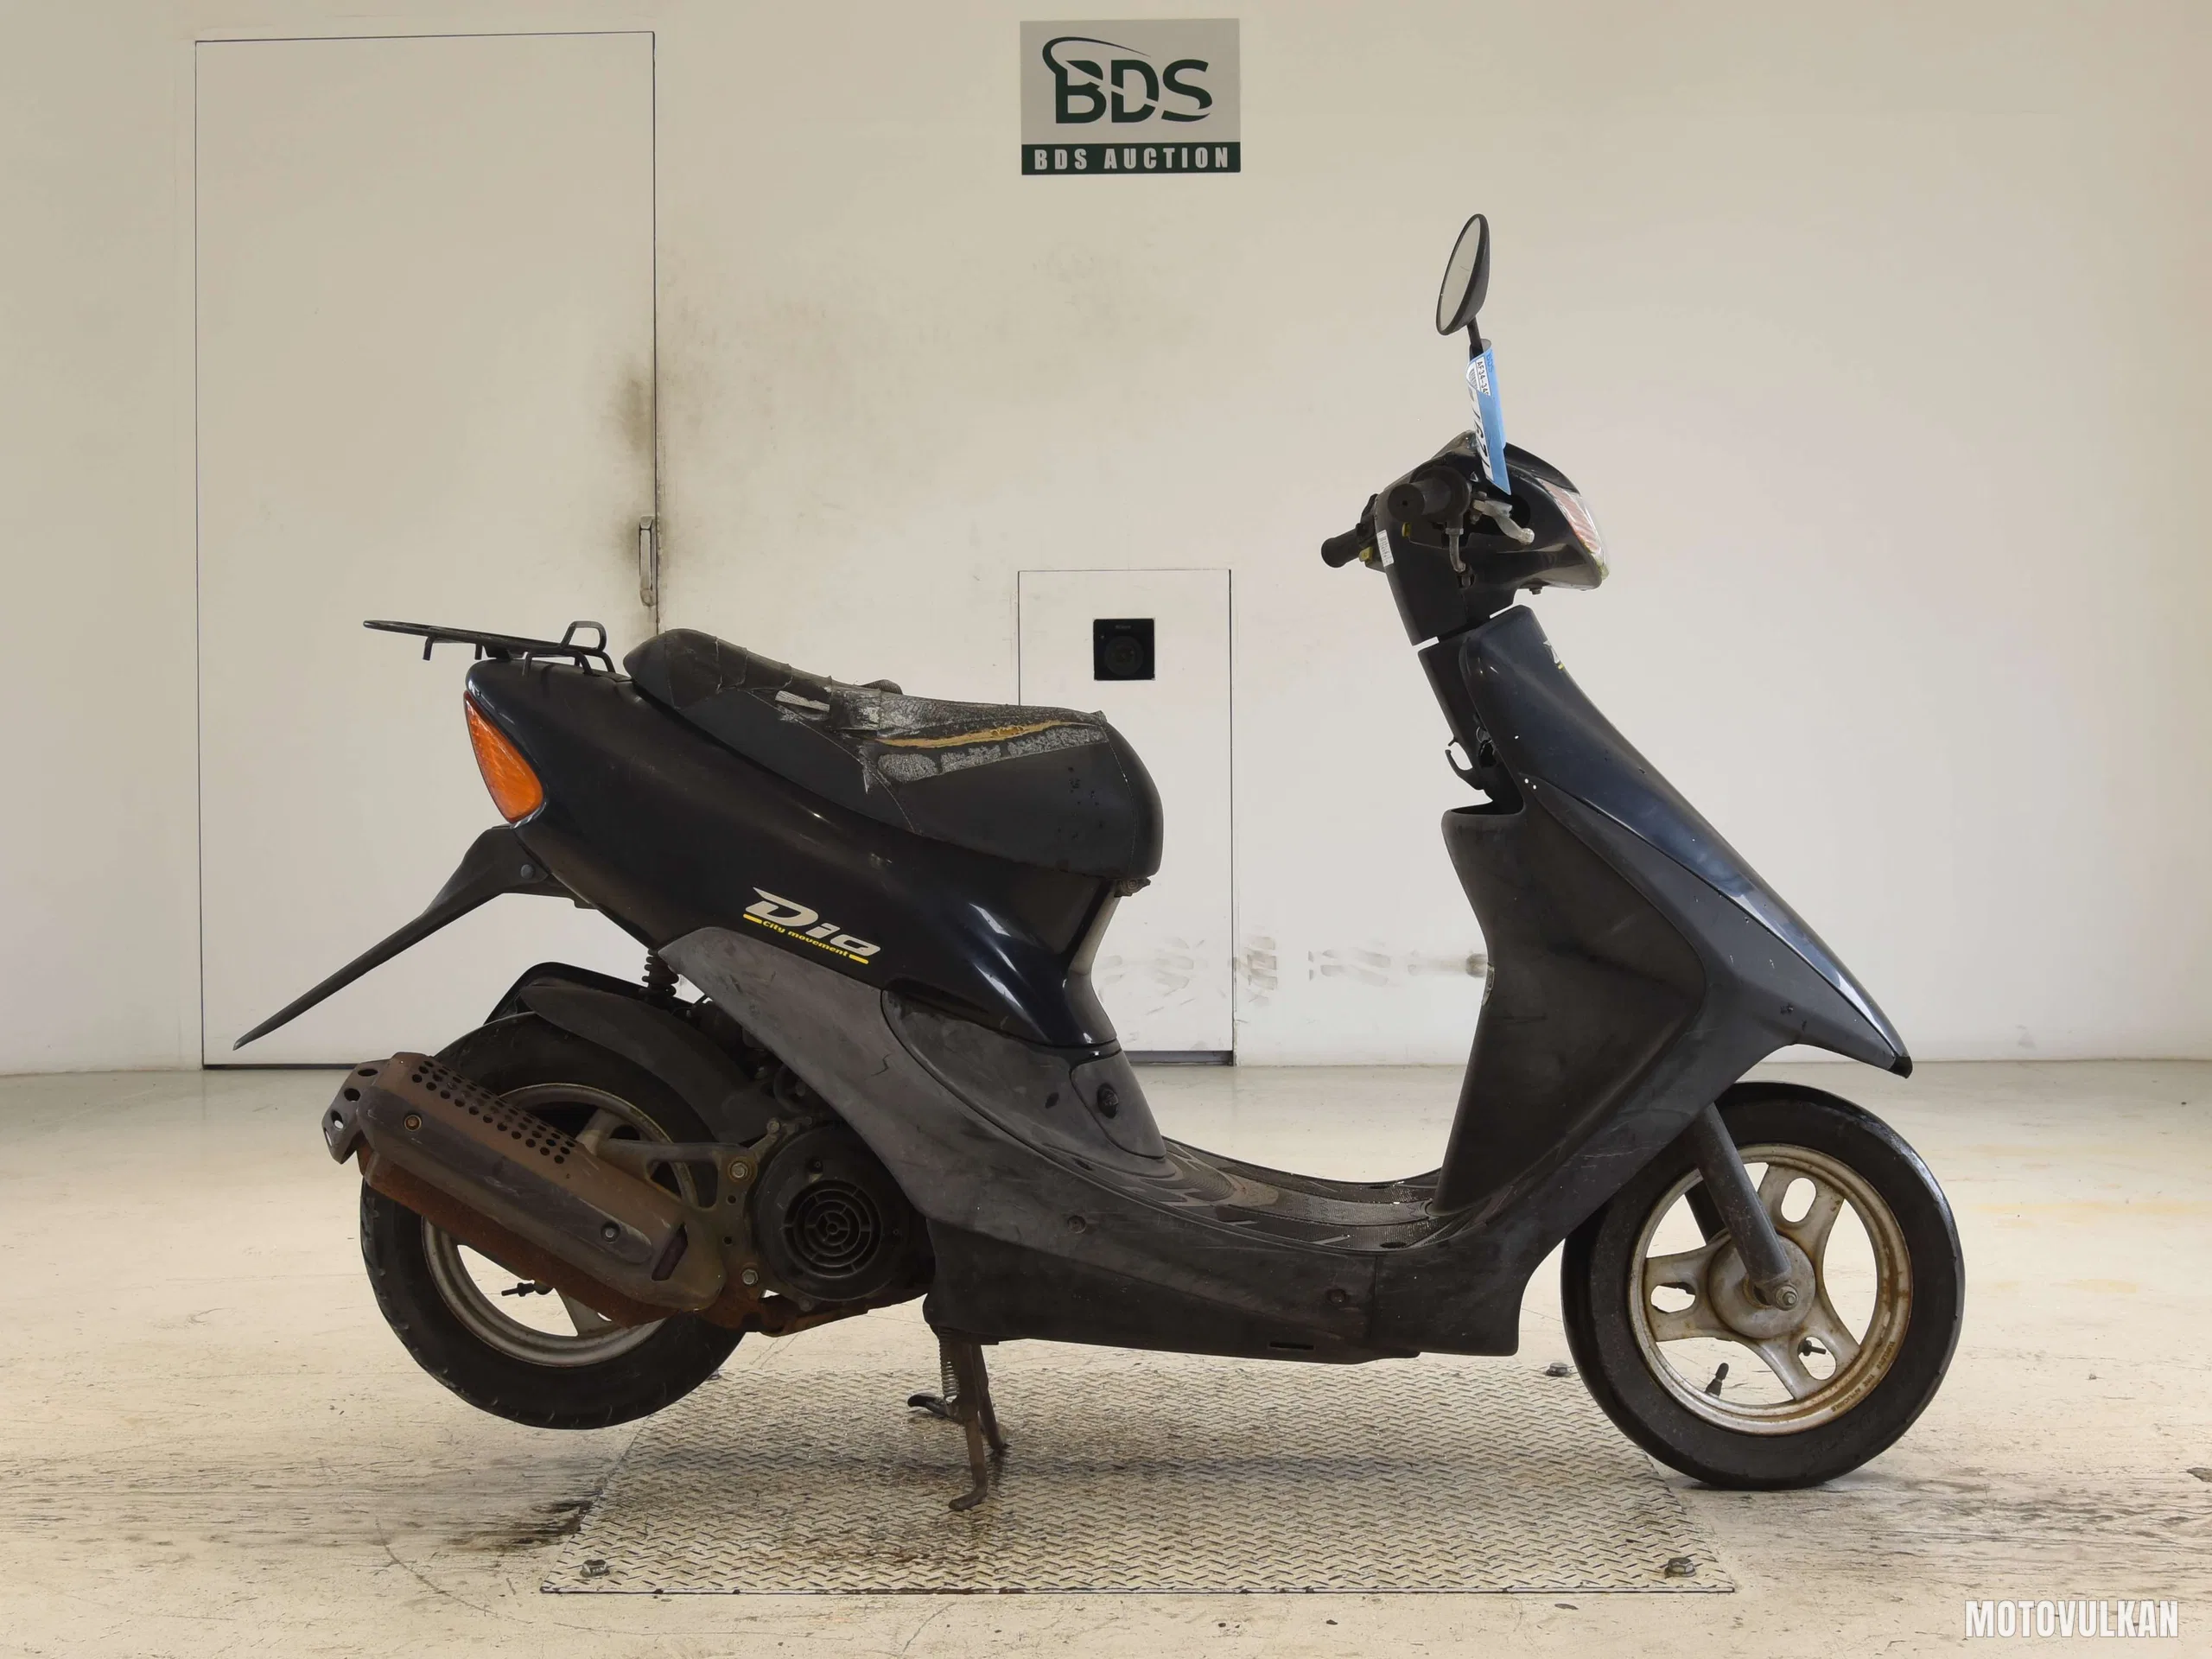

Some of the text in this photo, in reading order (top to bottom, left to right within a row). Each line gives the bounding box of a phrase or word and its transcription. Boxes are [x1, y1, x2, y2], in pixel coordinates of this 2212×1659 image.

[1042, 36, 1212, 124] BDS
[1034, 147, 1228, 170] BDS AUCTION
[745, 887, 880, 957] Dio
[762, 920, 849, 957] City movement
